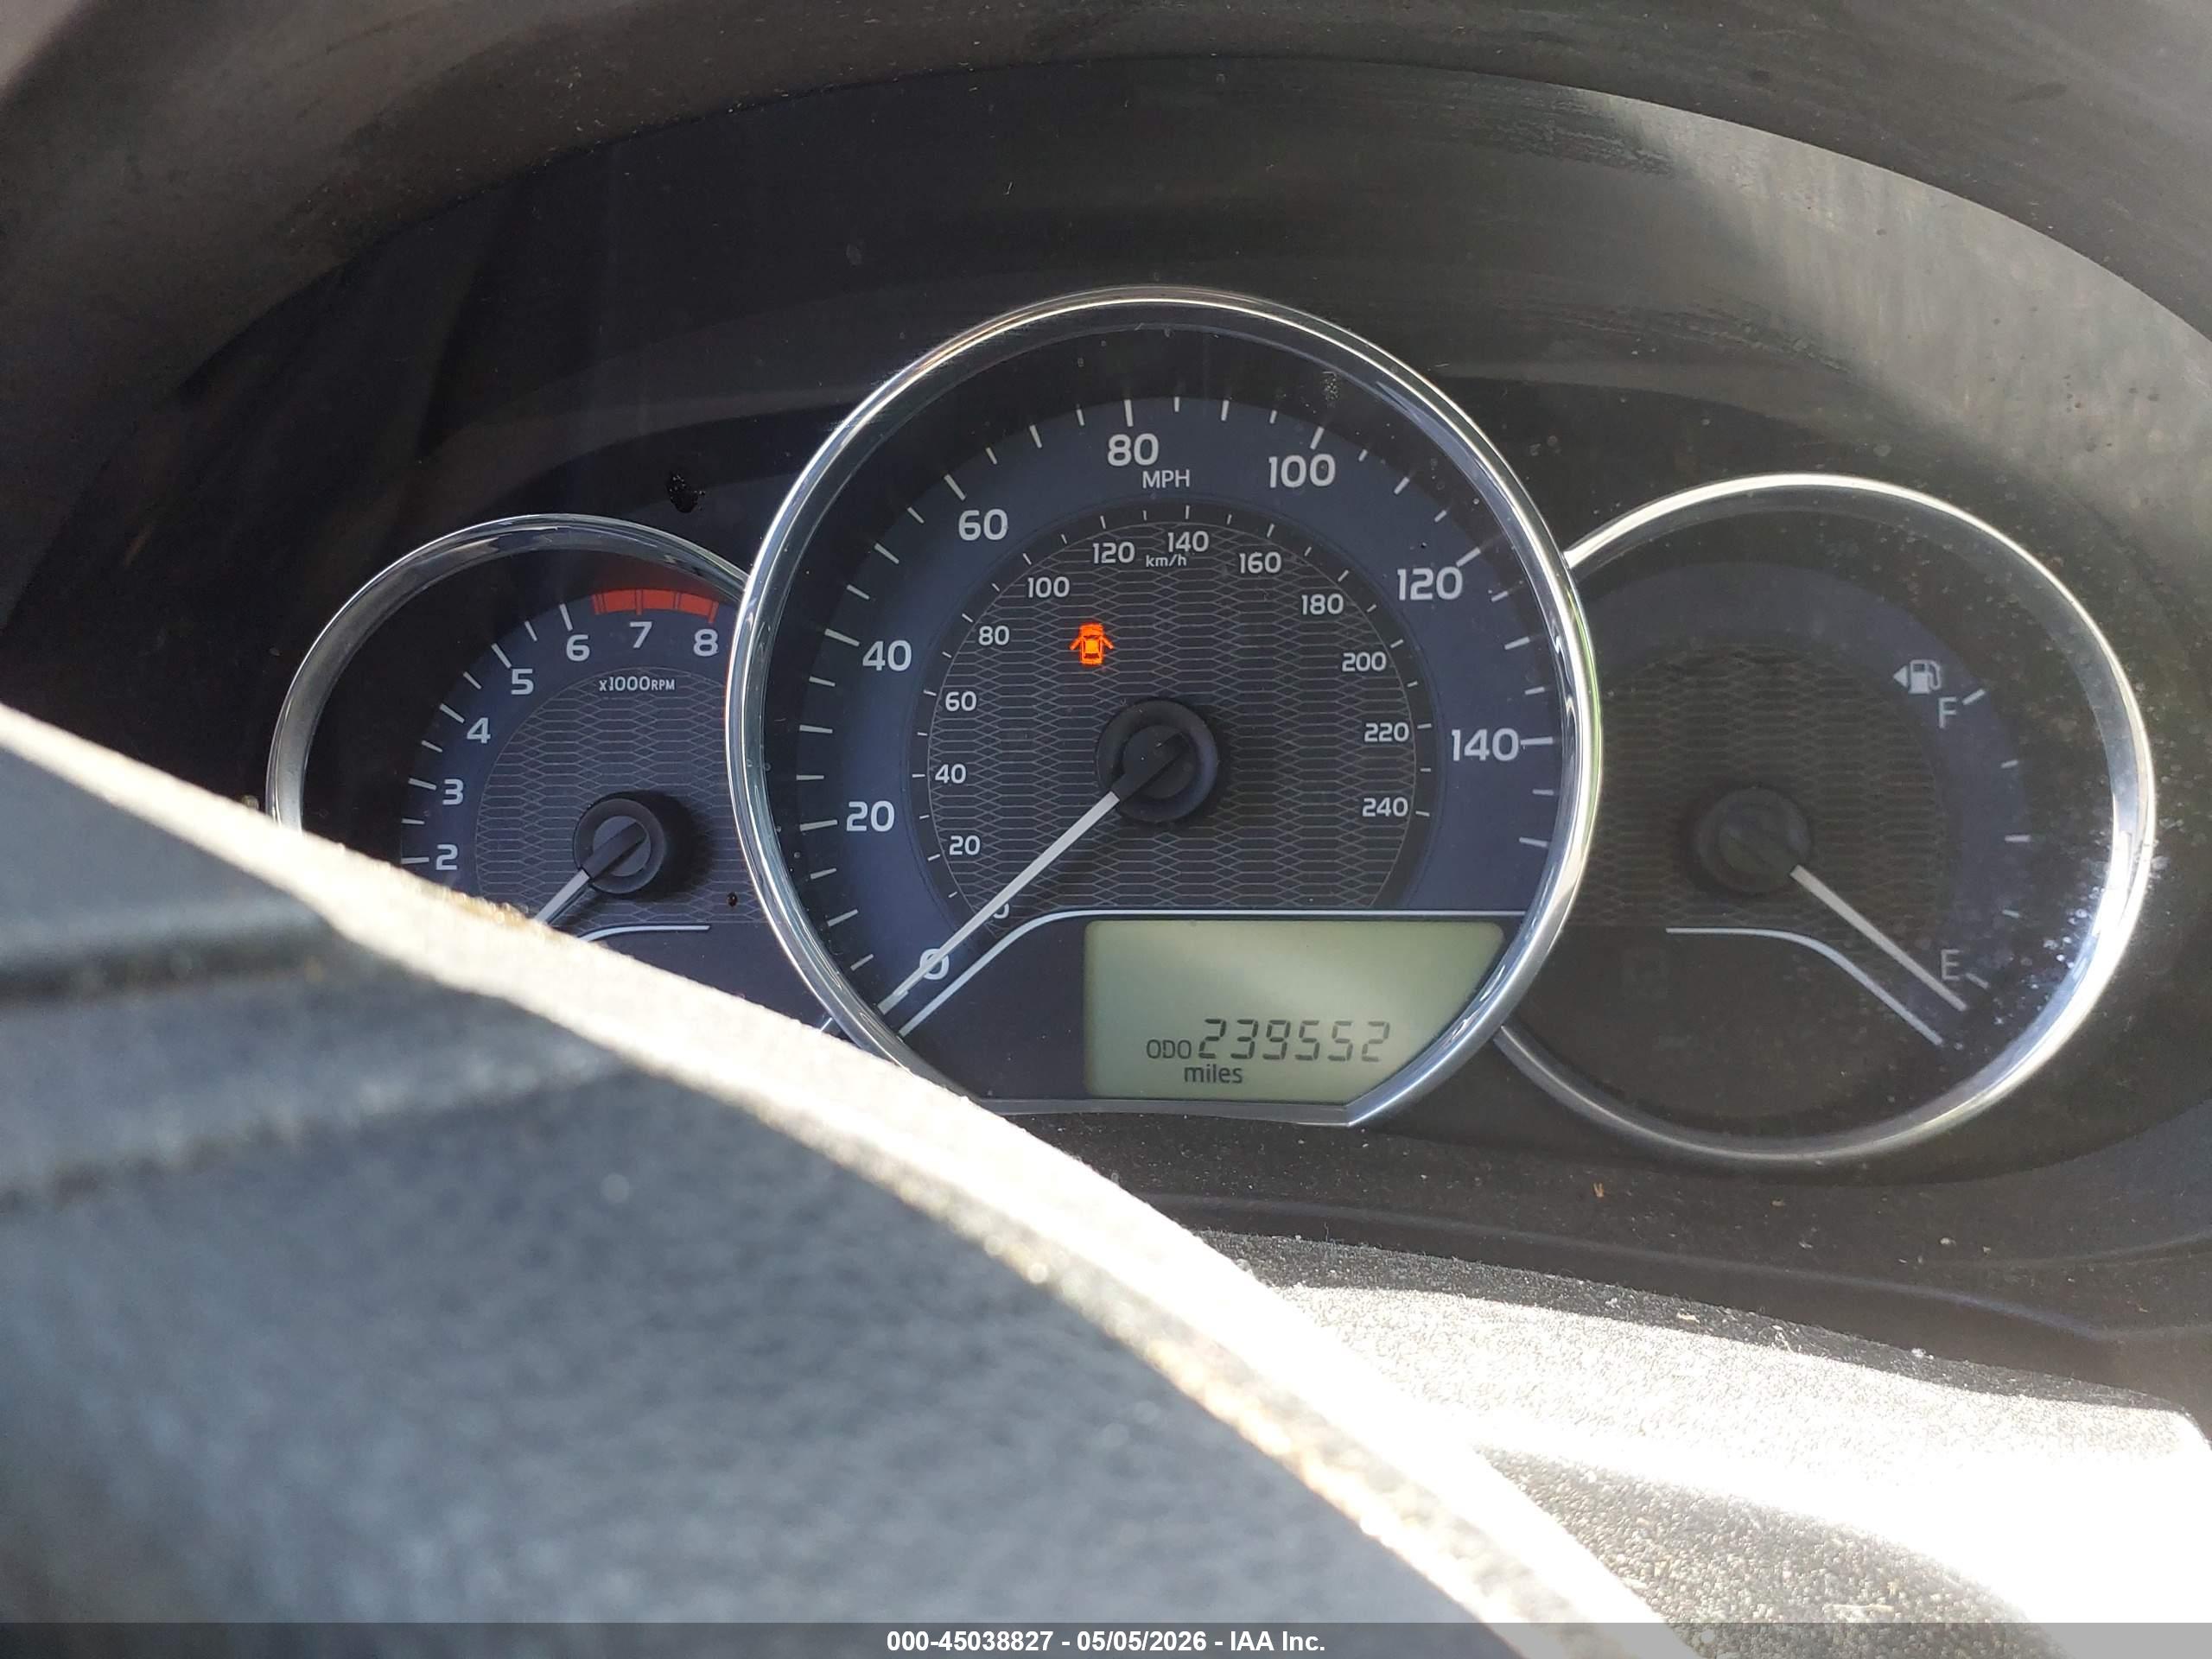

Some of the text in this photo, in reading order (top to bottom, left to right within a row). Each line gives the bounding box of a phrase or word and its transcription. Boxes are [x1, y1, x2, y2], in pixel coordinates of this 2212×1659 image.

[1108, 433, 1159, 467] 80
[1142, 469, 1190, 488] MPH
[1268, 454, 1336, 488] 100
[958, 509, 1007, 540] 60
[1092, 542, 1135, 563] 120
[1167, 531, 1209, 552] 140
[1146, 554, 1187, 569] km/h
[1239, 552, 1281, 574] 160
[1027, 576, 1070, 598] 100
[1397, 567, 1463, 601] 120
[1302, 594, 1344, 615] 180
[566, 634, 590, 661] 6
[629, 621, 653, 648] 7
[693, 629, 719, 656] 8
[978, 626, 1009, 645] 80
[862, 640, 912, 671] 40
[1342, 652, 1386, 671] 200
[511, 669, 534, 696] 5
[945, 692, 976, 711] 60
[1938, 697, 1957, 728] F
[467, 718, 491, 744] 4
[1364, 722, 1409, 742] 220
[1451, 728, 1520, 761] 140
[935, 765, 966, 784] 40
[442, 779, 464, 805] 3
[846, 800, 895, 831] 20
[1363, 798, 1408, 817] 240
[435, 844, 458, 871] 2
[949, 836, 981, 855] 20
[1942, 950, 1960, 981] E
[1146, 1019, 1390, 1062] ODO 239552
[1184, 1065, 1243, 1084] miles
